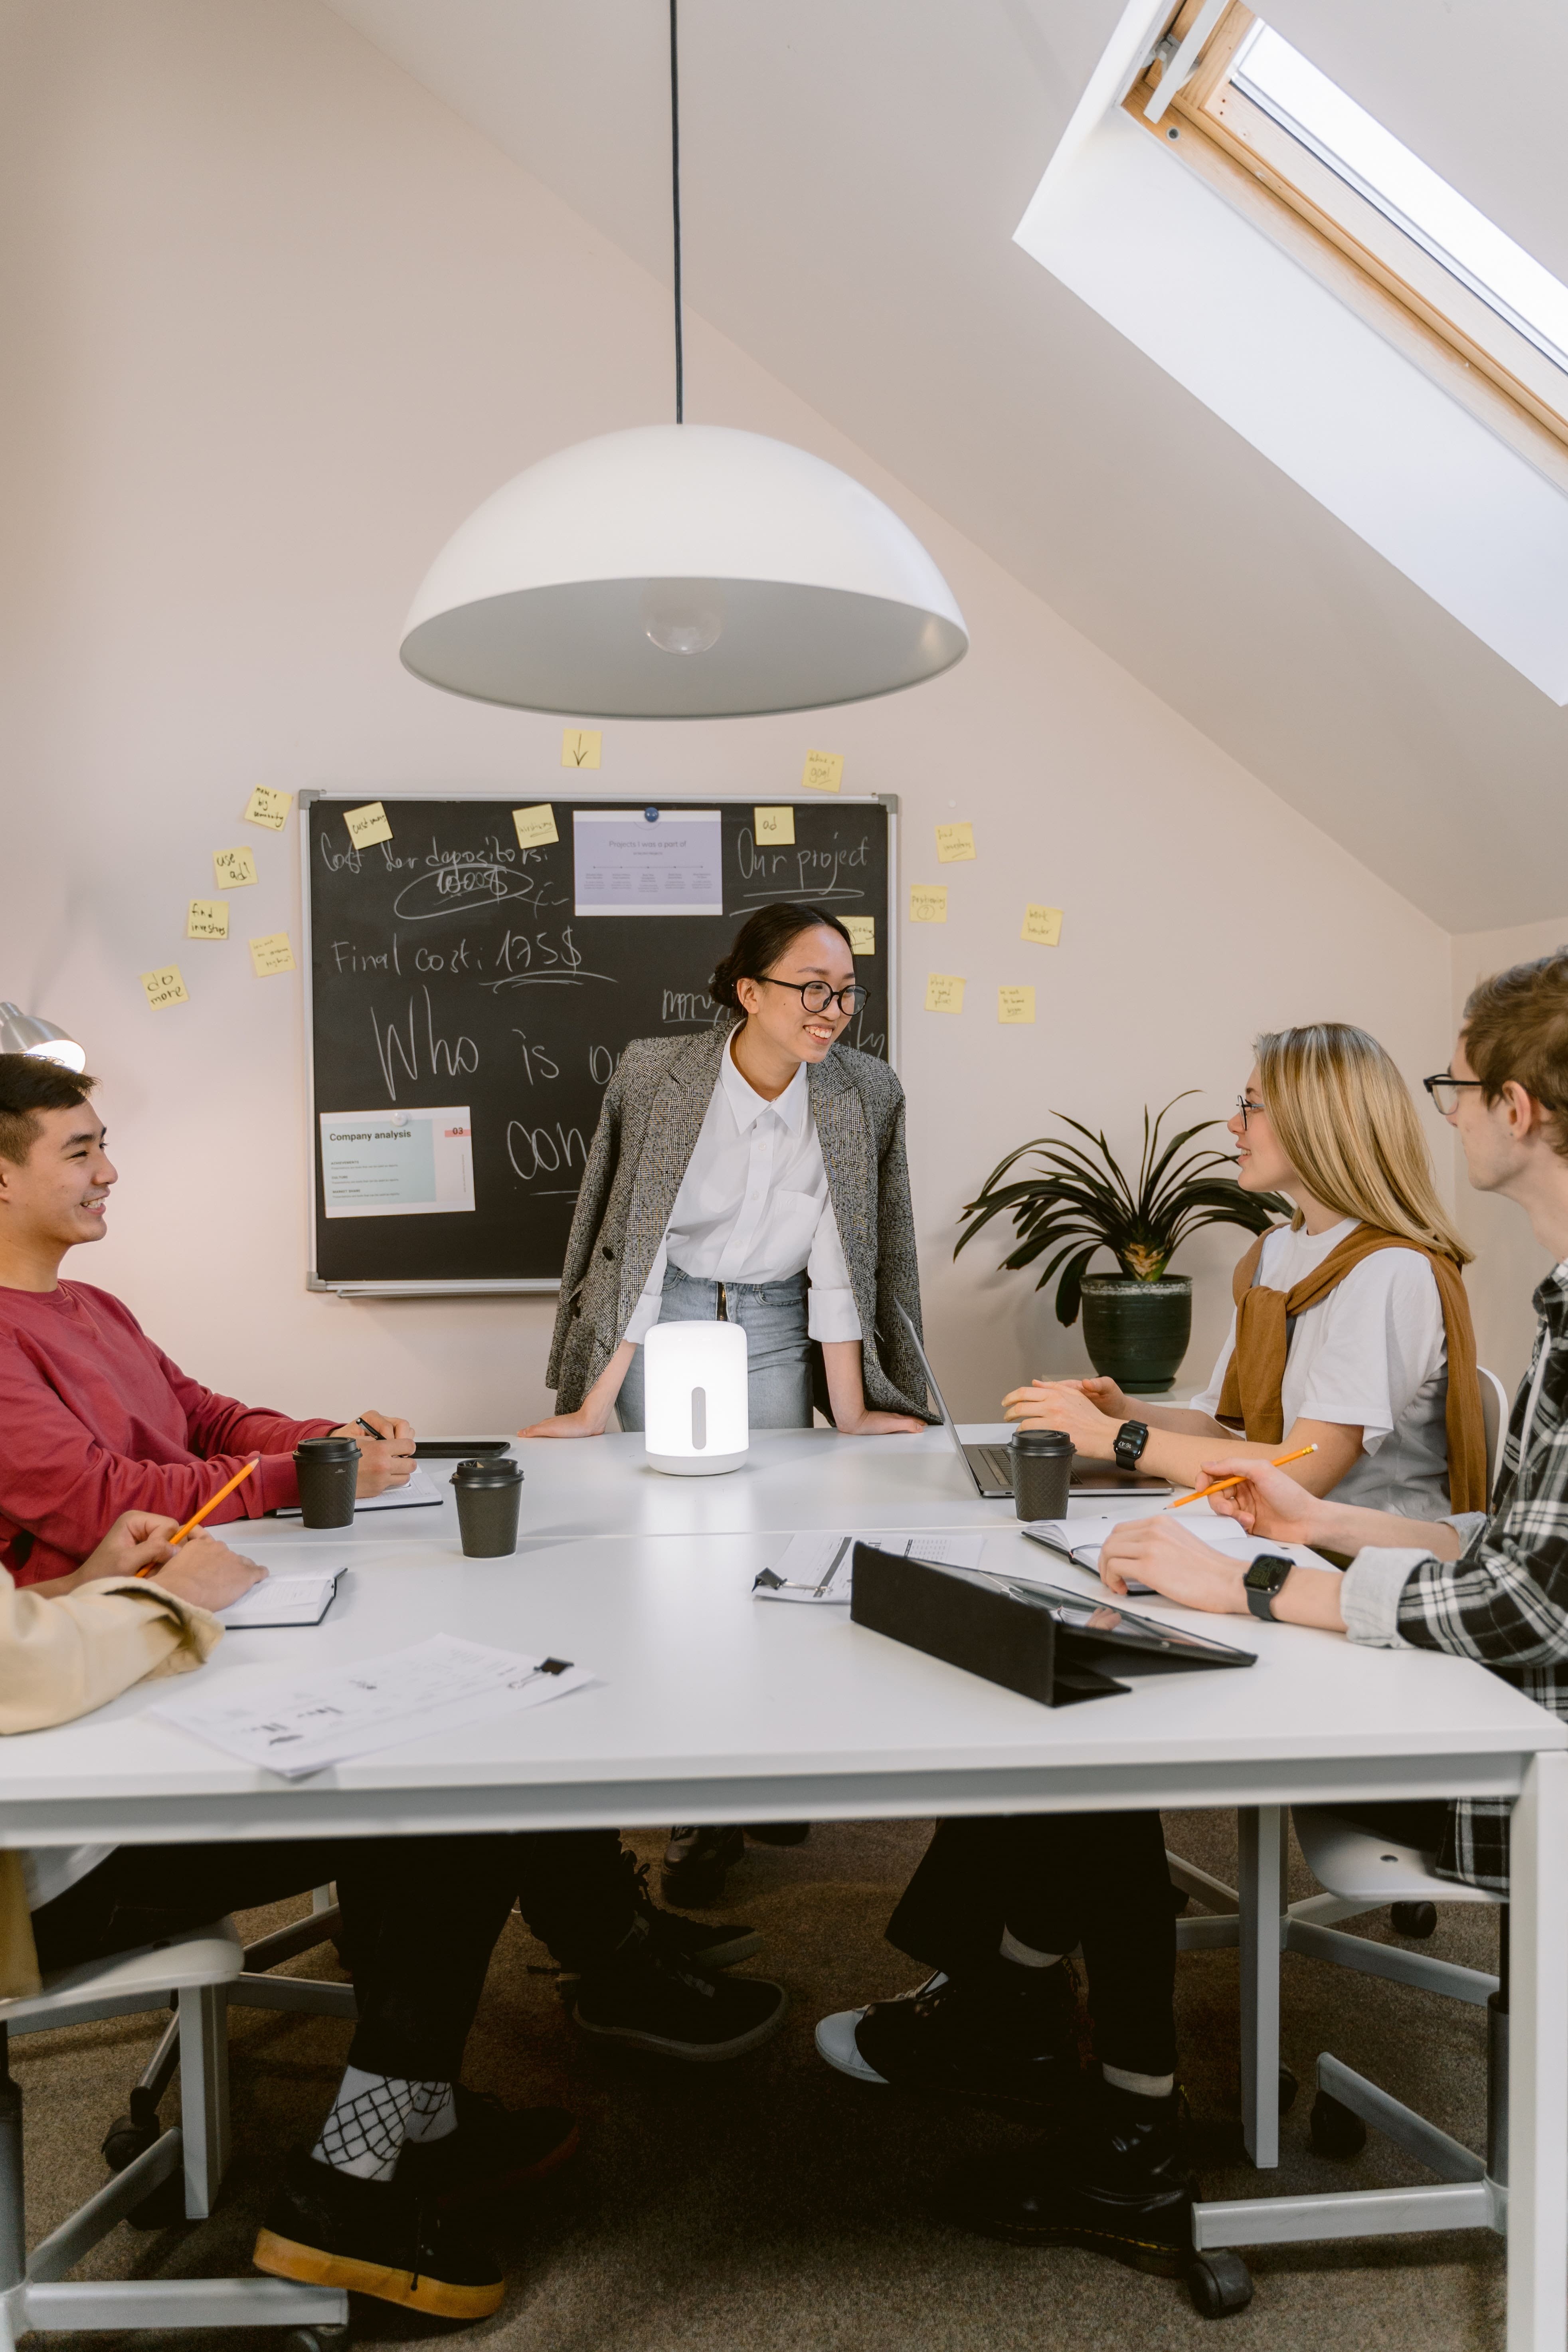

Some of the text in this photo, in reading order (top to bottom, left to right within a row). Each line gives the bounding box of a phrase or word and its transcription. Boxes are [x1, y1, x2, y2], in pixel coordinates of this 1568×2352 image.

[809, 767, 830, 783] goal
[258, 799, 269, 811] big
[216, 853, 235, 867] use
[738, 827, 871, 895] Our project
[192, 903, 213, 918] find
[191, 923, 225, 936] investors
[331, 933, 401, 975] Final
[147, 973, 174, 991] do
[150, 985, 184, 1005] more
[371, 985, 479, 1101] Who
[512, 1029, 560, 1086] is
[330, 1130, 411, 1142] Company analysis
